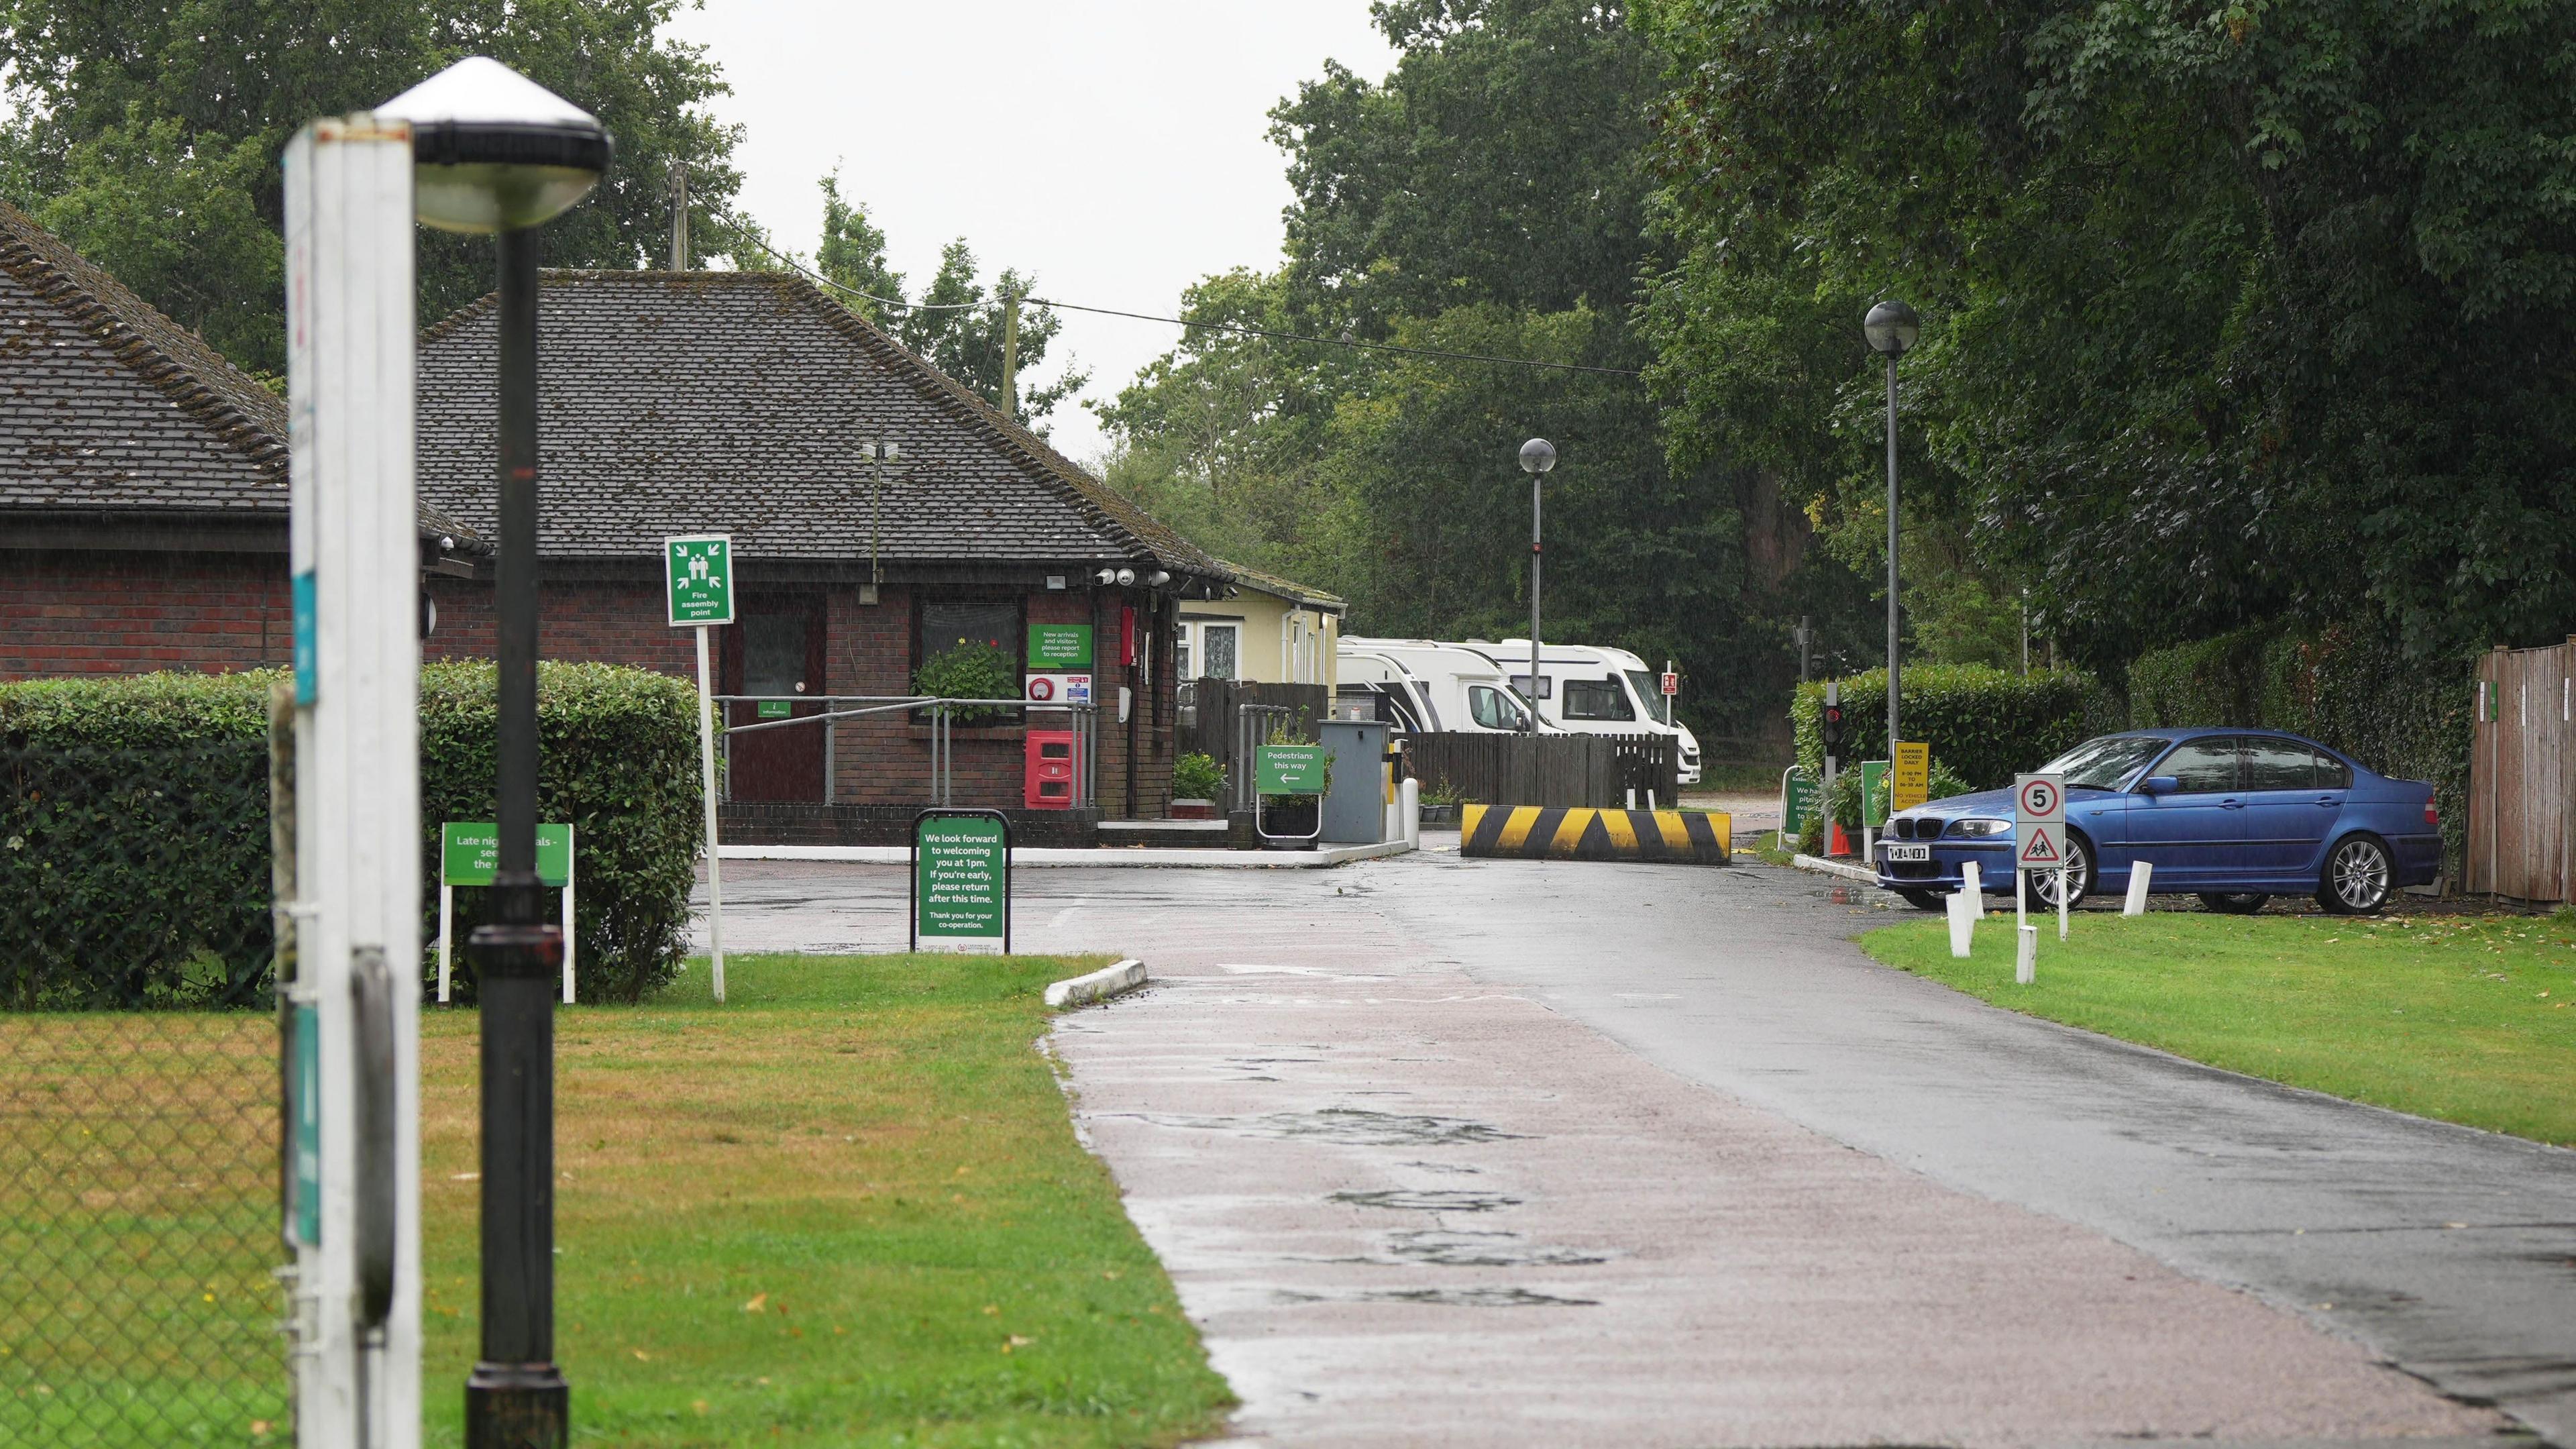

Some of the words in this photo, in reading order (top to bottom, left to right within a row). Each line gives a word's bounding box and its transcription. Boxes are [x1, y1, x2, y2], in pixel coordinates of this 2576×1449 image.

[682, 600, 718, 608] assembly
[691, 609, 710, 617] point
[2033, 790, 2046, 808] 5
[457, 837, 479, 845] Late
[925, 835, 940, 843] We
[942, 834, 961, 843] look
[963, 835, 998, 843] forward
[931, 847, 942, 855] to
[943, 847, 991, 857] welcoming
[474, 860, 491, 869] the
[966, 860, 987, 869] 1pm.
[930, 871, 936, 879] If
[938, 871, 965, 881] you're
[967, 872, 991, 881] early,
[932, 883, 960, 892] please
[928, 895, 950, 903] after
[952, 895, 967, 903] this
[970, 895, 993, 903] time.
